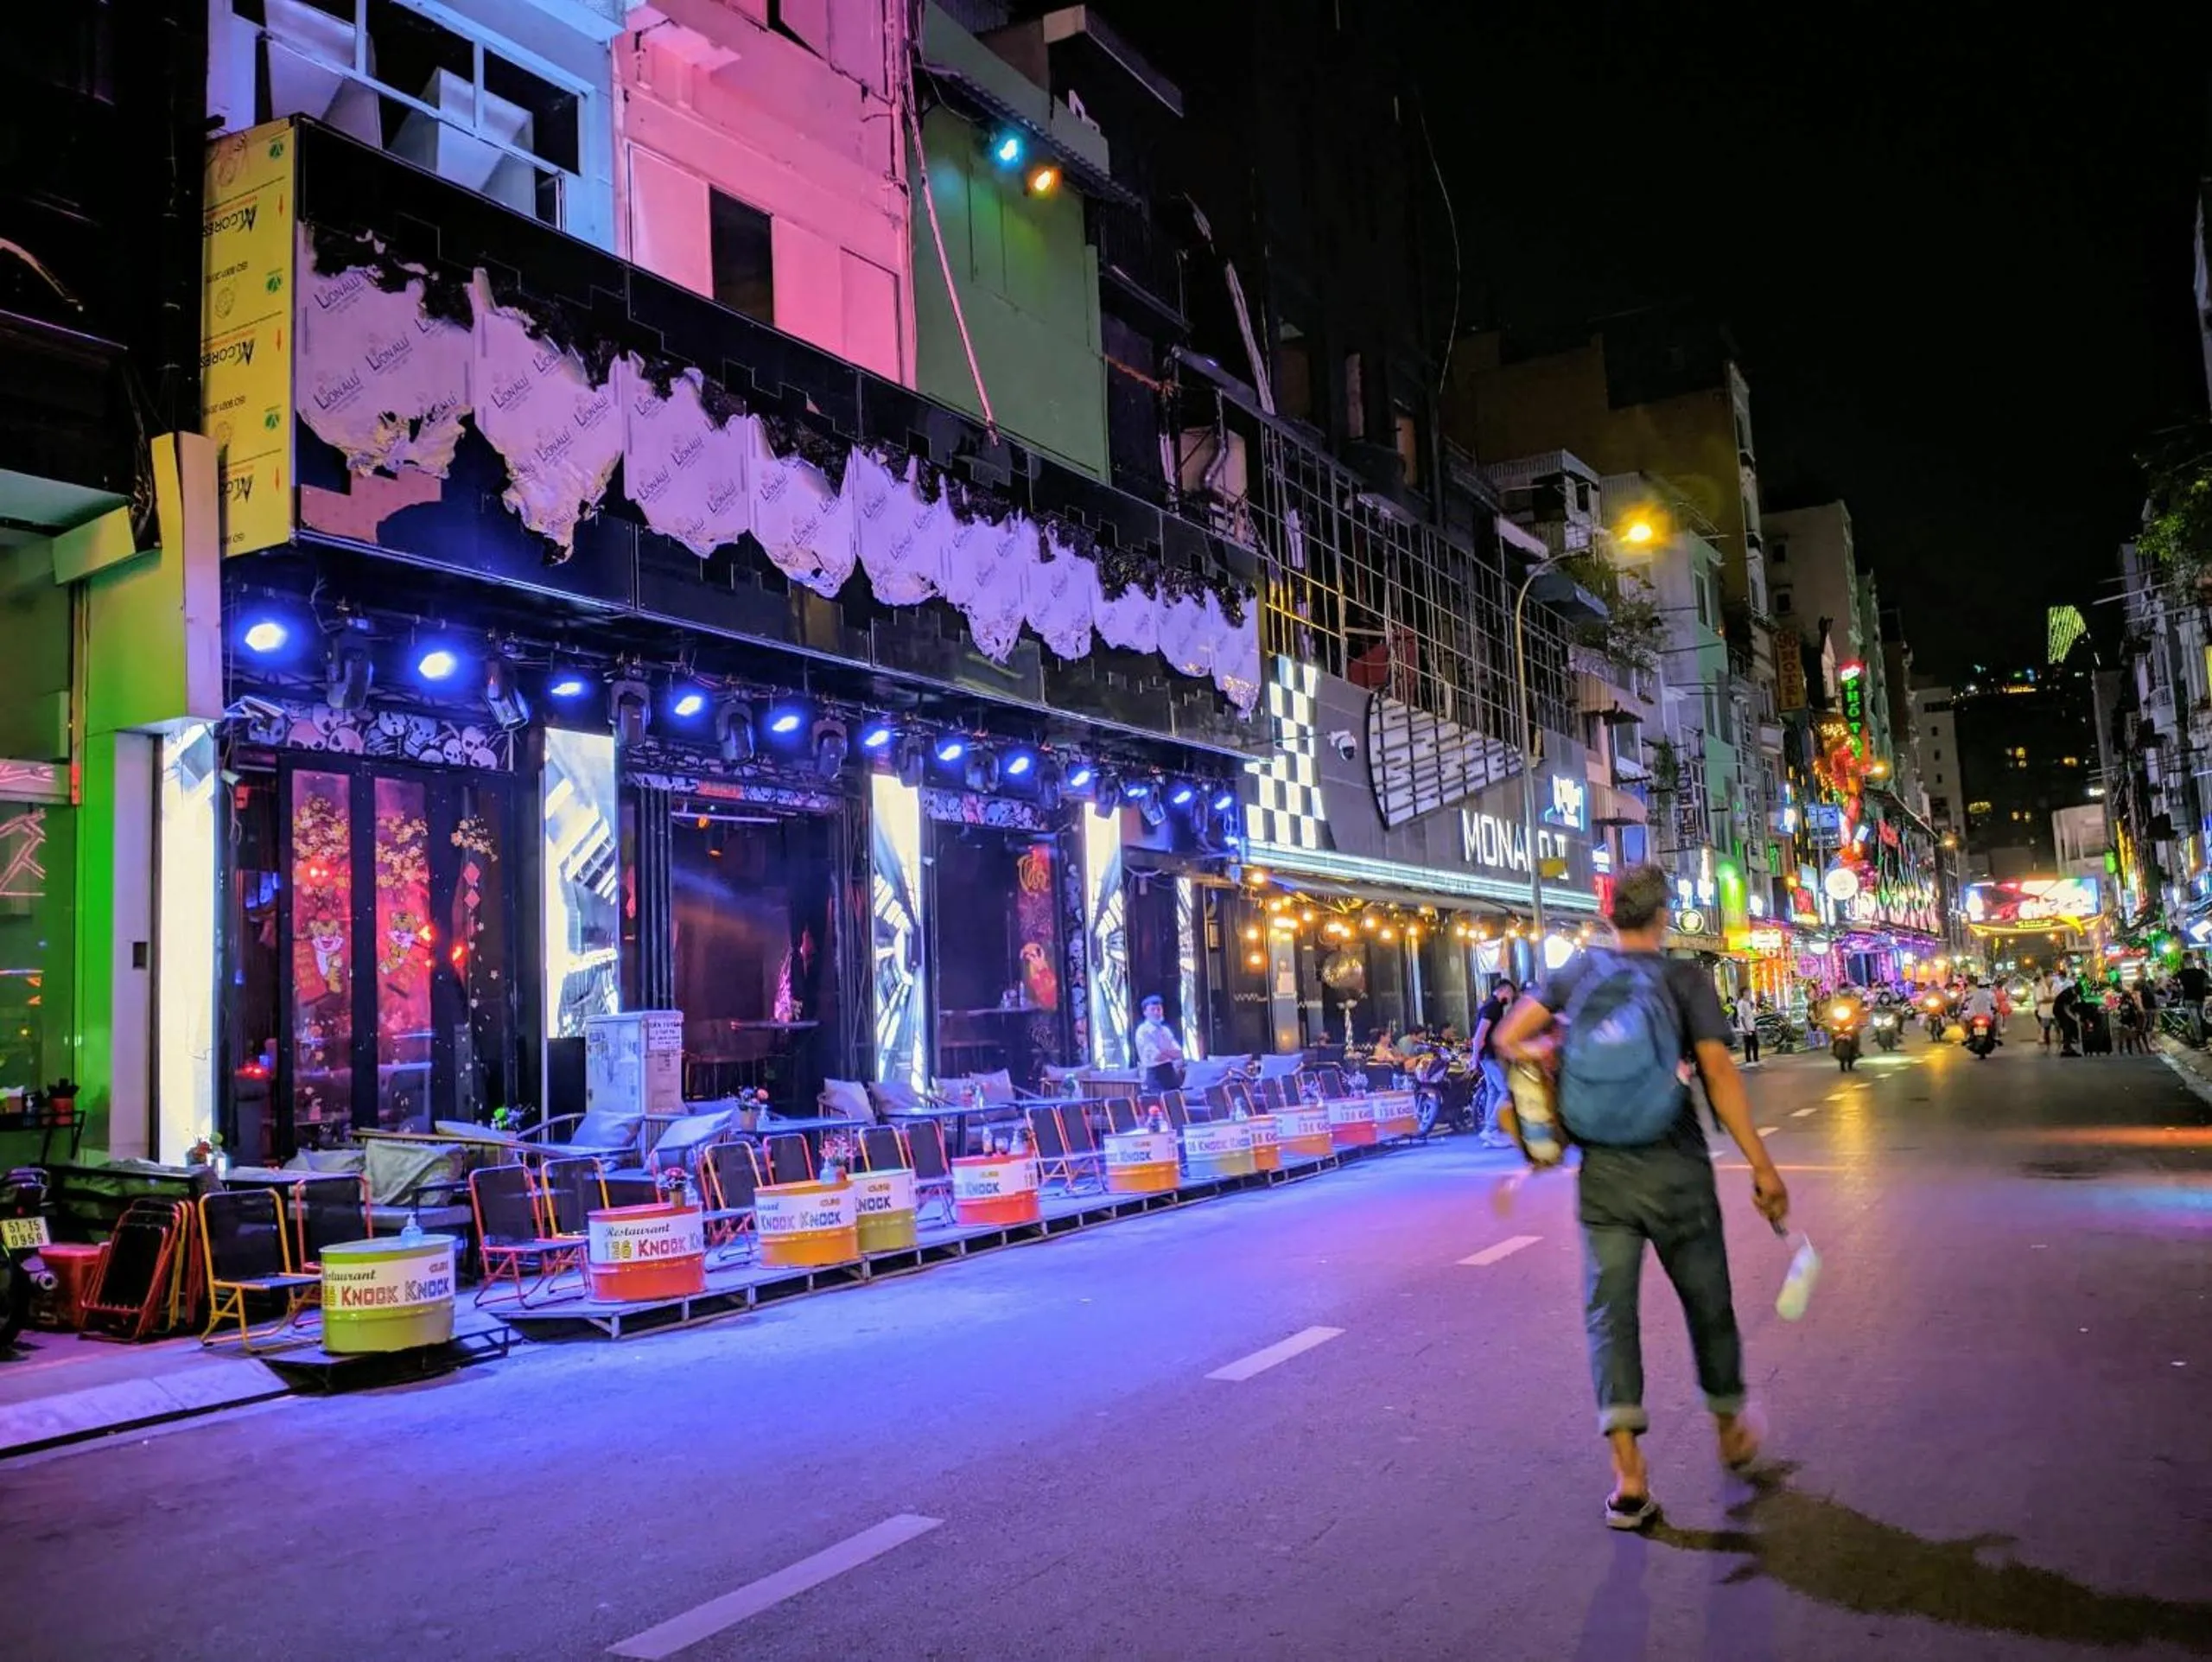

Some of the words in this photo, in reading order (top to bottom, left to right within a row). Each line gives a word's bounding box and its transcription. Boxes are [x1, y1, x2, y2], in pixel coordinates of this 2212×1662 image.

[605, 1223, 670, 1238] Restaurant
[638, 1236, 687, 1258] KNOCK
[341, 1285, 398, 1306] KNOCK
[404, 1277, 449, 1302] KNOCK
